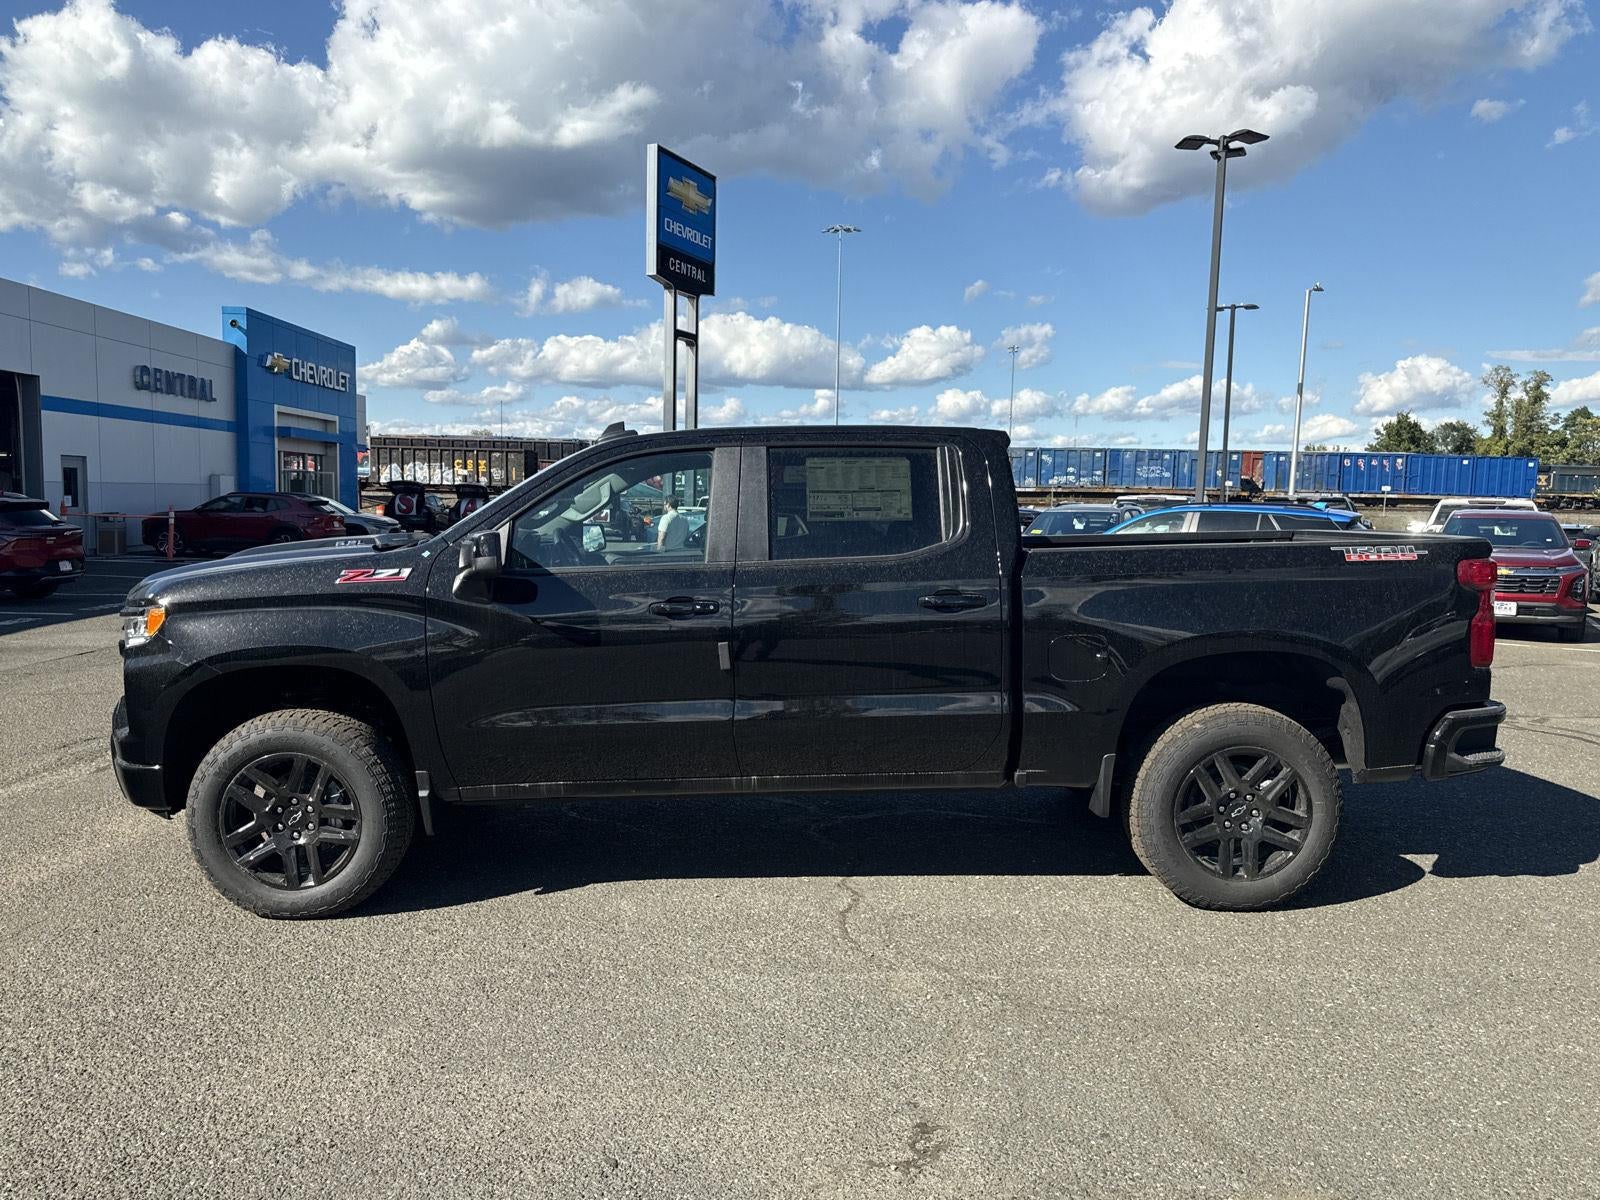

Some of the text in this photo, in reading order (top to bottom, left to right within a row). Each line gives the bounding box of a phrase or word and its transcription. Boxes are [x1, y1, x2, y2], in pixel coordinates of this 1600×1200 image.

[664, 217, 713, 249] CHEVROLET
[668, 257, 706, 283] CENTRAL
[134, 365, 217, 402] CENTRAL
[291, 357, 350, 393] CHEVROLET
[1330, 545, 1428, 555] TRAIL
[1345, 553, 1418, 561] BOSS
[335, 567, 413, 584] Z71
